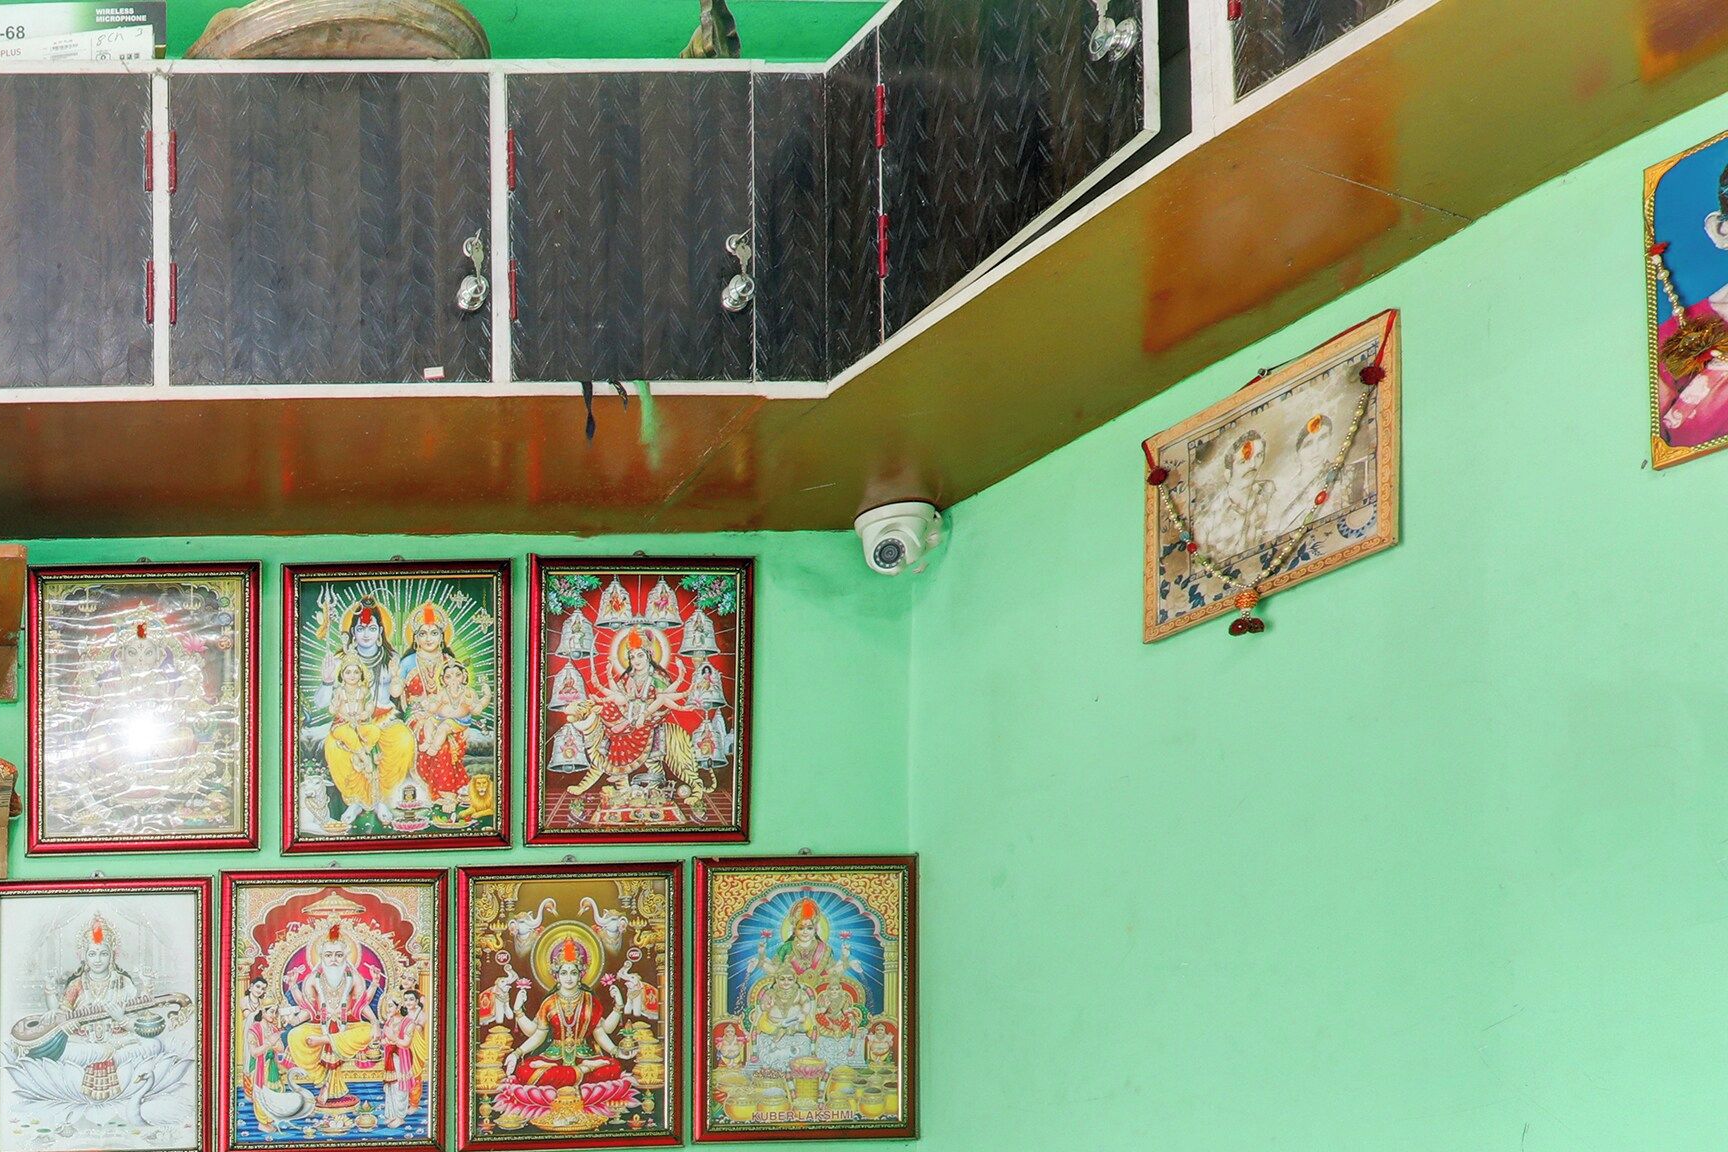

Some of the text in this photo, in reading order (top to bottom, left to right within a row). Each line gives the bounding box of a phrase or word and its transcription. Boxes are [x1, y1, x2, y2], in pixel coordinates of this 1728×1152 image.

[95, 7, 135, 15] WIRELESS
[95, 15, 147, 23] MICROPHONE
[0, 48, 22, 58] PLUS
[752, 1110, 854, 1121] KUBER LAKSHMI
